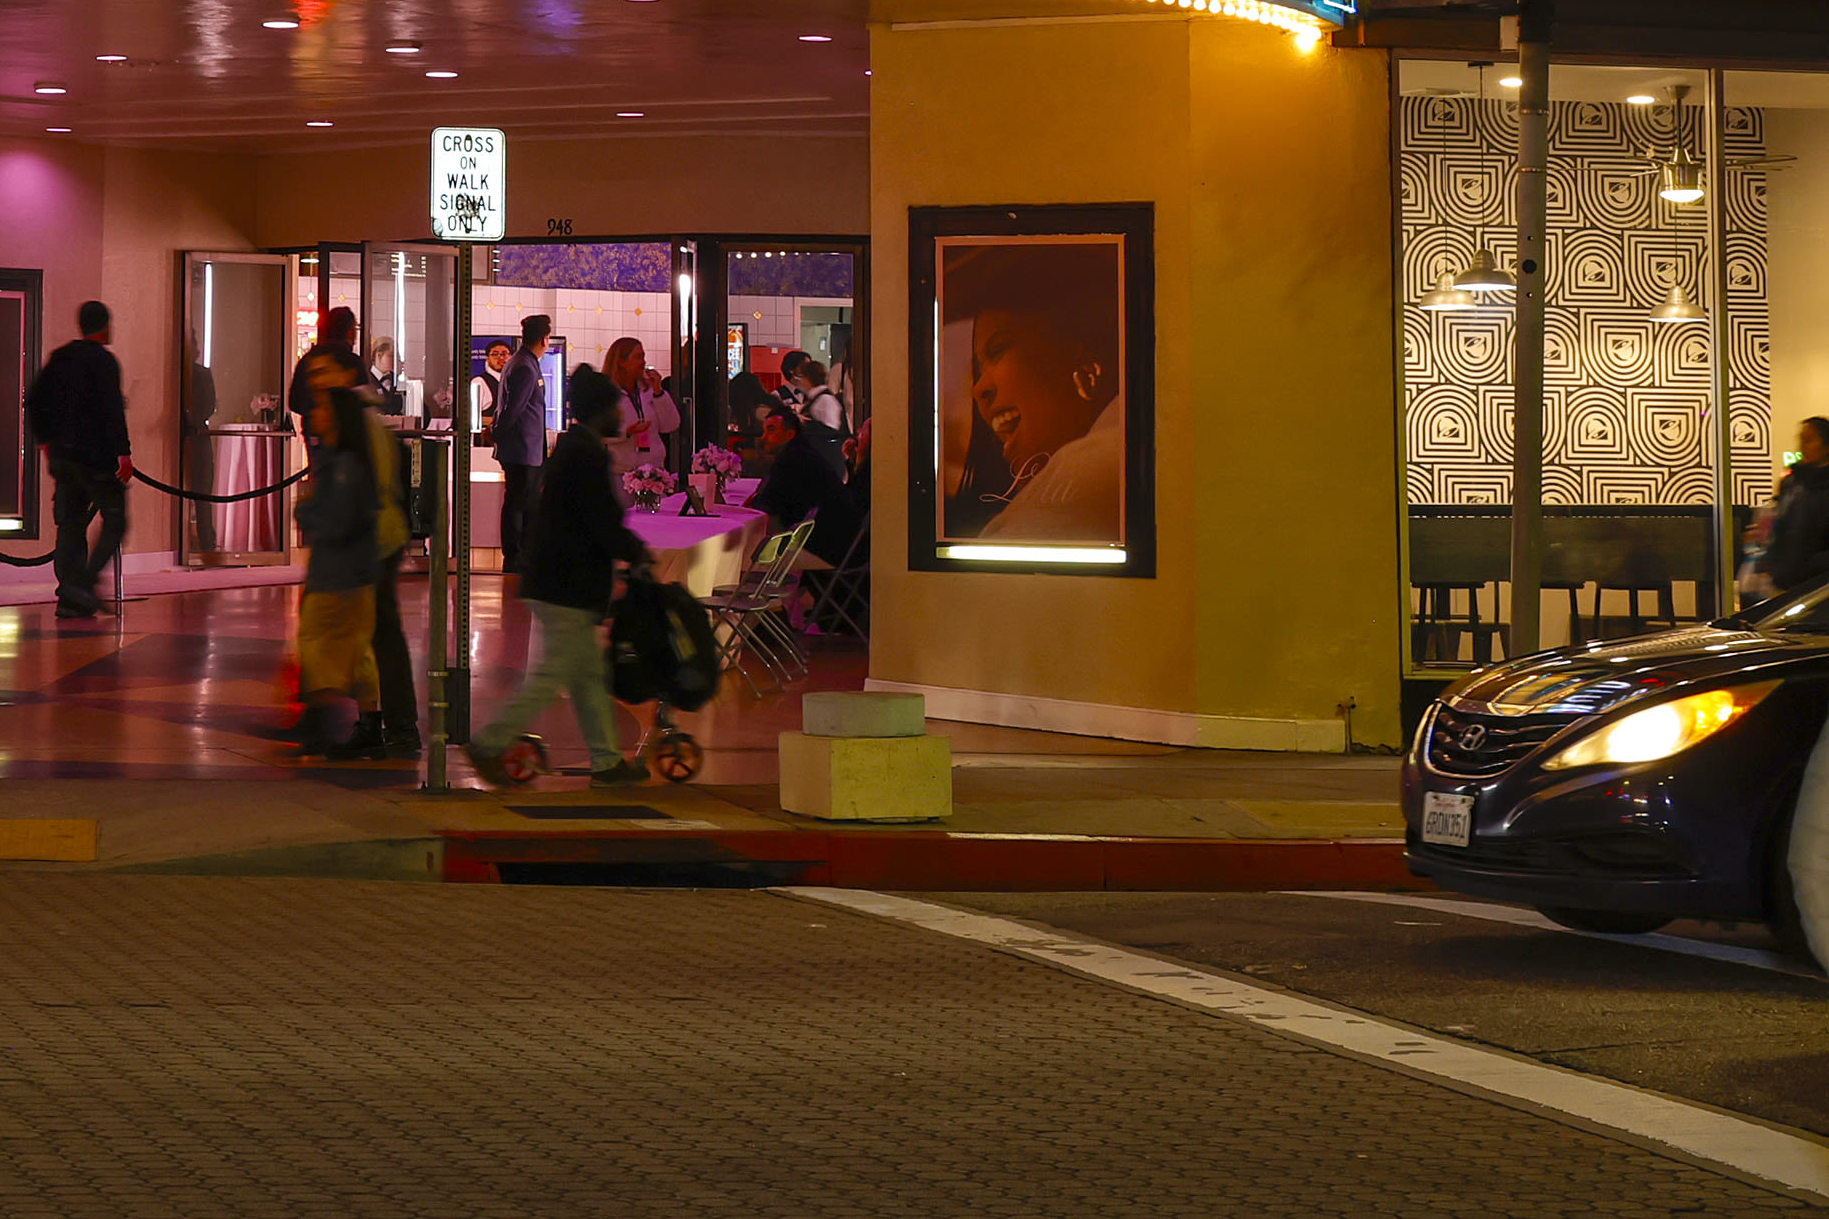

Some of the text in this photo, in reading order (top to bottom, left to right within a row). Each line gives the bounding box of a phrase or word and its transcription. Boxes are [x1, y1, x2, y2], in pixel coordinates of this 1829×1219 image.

[442, 134, 494, 153] CROSS
[460, 156, 477, 170] ON
[447, 173, 489, 190] WALK
[439, 193, 497, 212] SIGNAL
[447, 215, 488, 233] ONLY
[546, 218, 574, 236] 948
